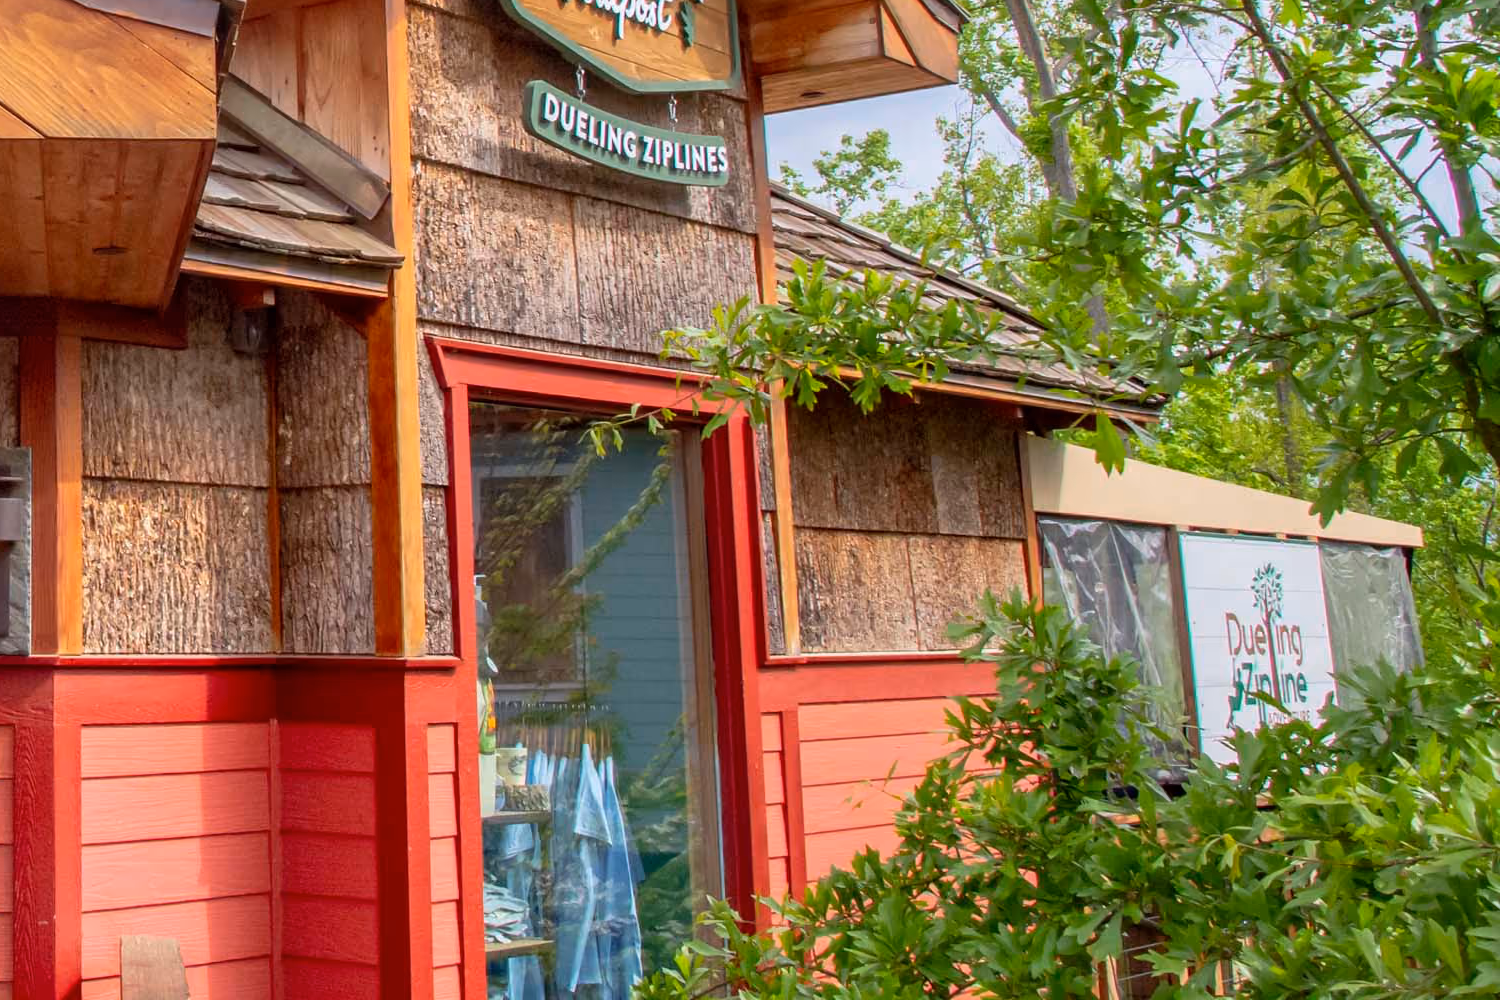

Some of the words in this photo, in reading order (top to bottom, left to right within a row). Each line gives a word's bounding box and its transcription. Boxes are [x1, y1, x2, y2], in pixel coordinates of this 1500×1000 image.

[543, 92, 638, 159] DUELING
[642, 135, 729, 173] ZIPLINES
[1225, 612, 1304, 667] Dueling
